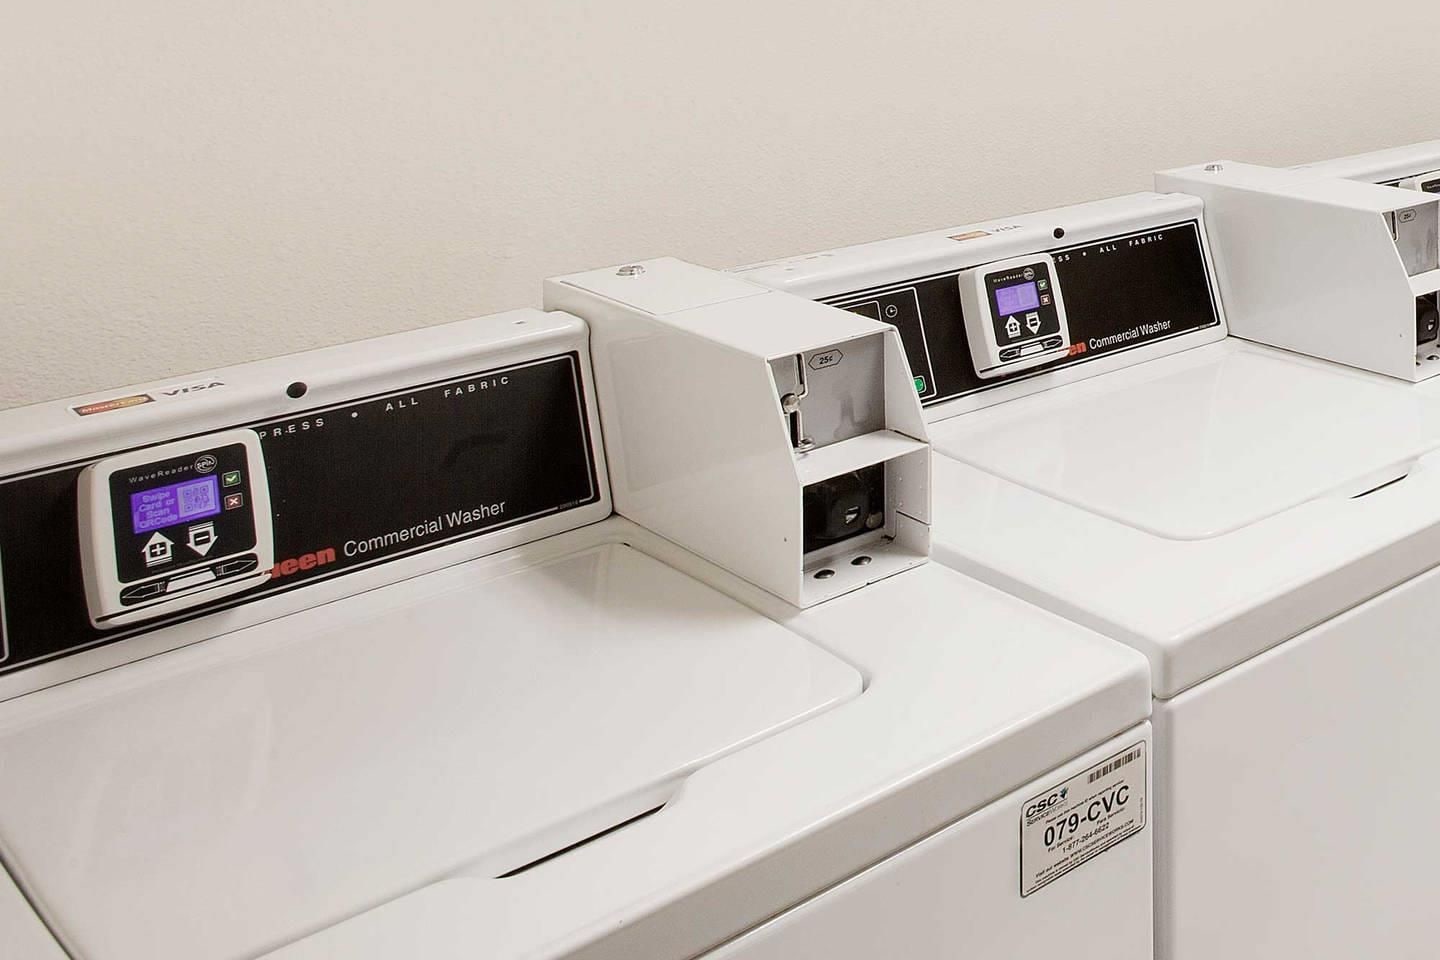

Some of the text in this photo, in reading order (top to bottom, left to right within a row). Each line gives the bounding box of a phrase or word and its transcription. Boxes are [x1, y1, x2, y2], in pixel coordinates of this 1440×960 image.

[1099, 234, 1164, 254] ALL FABRIC
[1089, 331, 1139, 350] Commercial
[1141, 320, 1171, 337] Washer
[161, 382, 225, 396] VISA
[385, 398, 418, 411] ALL
[444, 377, 509, 398] FABRIC
[129, 465, 193, 483] WaveReader
[139, 501, 162, 511] Card
[142, 491, 171, 502] Swipe
[146, 508, 170, 518] Scan
[343, 517, 443, 557] Commercial
[446, 501, 506, 528] Washer
[1026, 793, 1058, 818] CSC
[1044, 785, 1129, 846] 079-CVC
